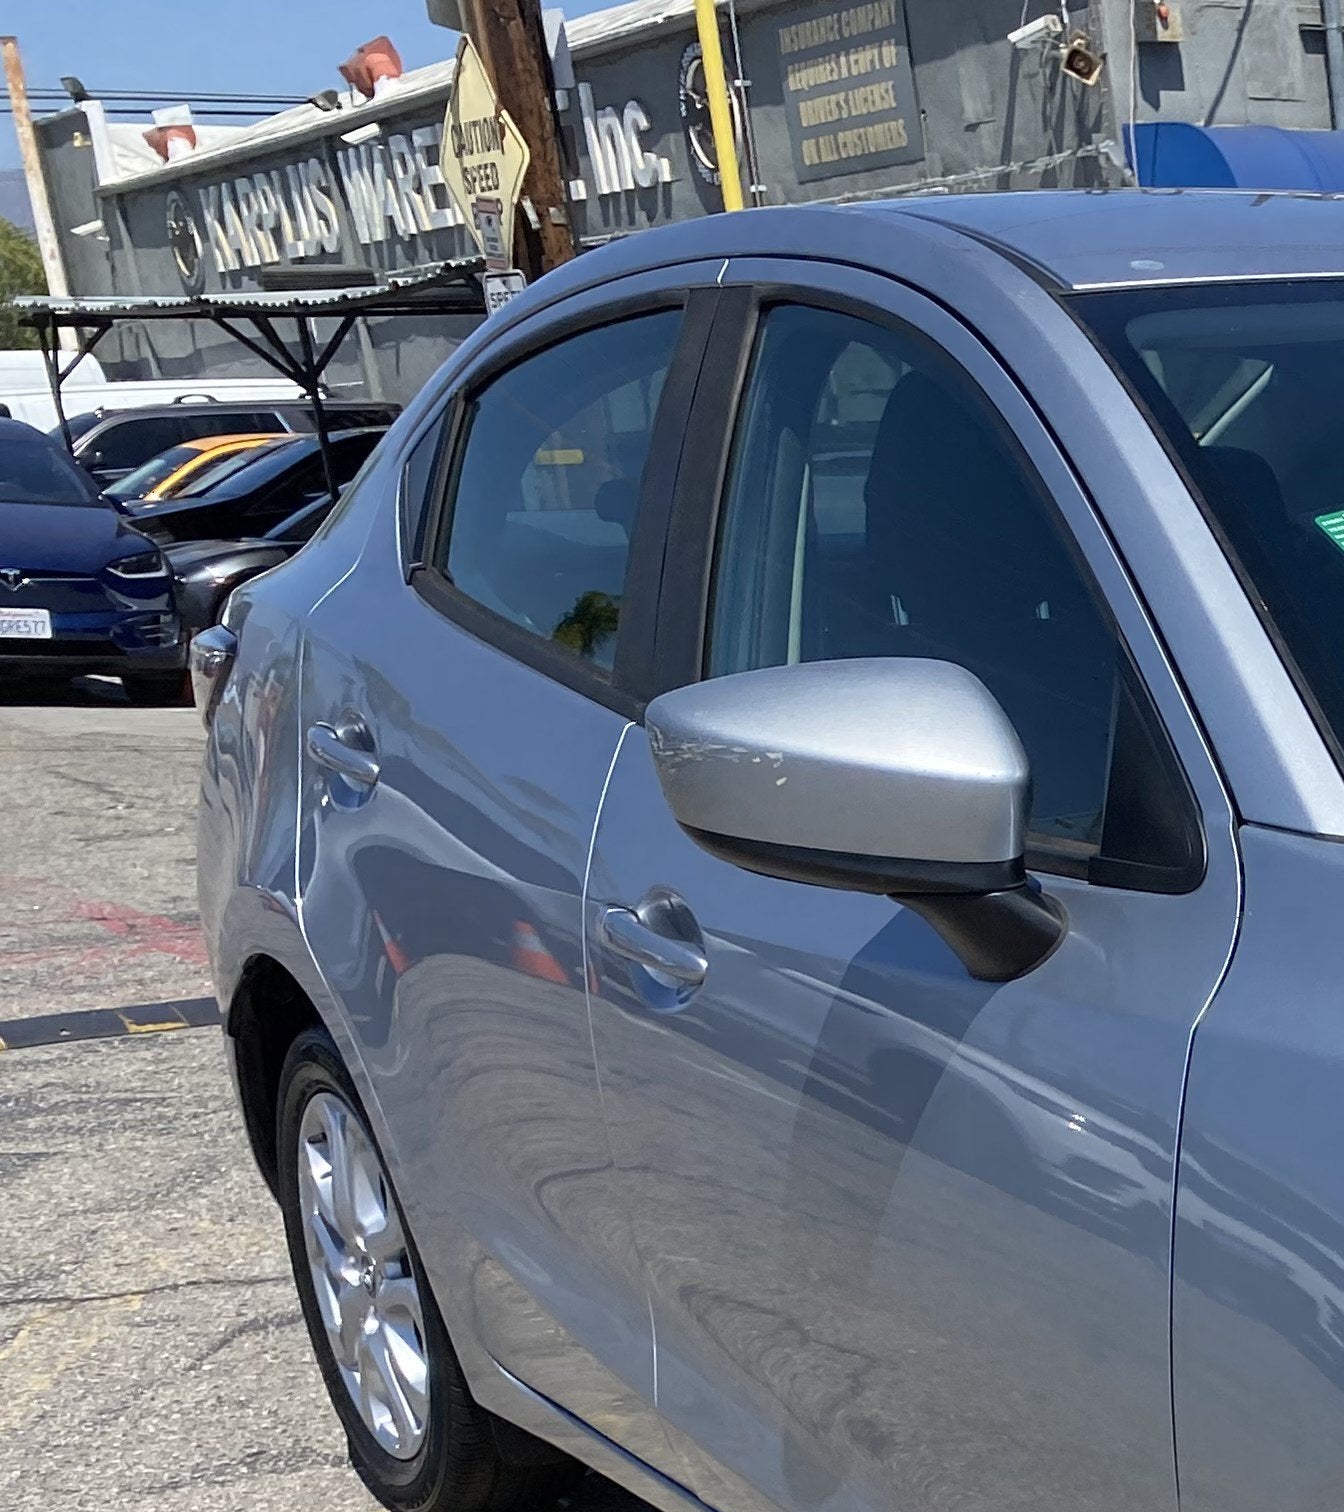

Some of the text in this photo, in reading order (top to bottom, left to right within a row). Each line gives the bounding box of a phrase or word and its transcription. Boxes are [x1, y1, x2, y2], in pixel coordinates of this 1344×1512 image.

[841, 0, 896, 38] COMPANY
[848, 80, 896, 117] LICENSE
[837, 118, 908, 159] CUSTOMERS
[463, 161, 500, 195] SPEED
[198, 158, 340, 273] KARPLUS
